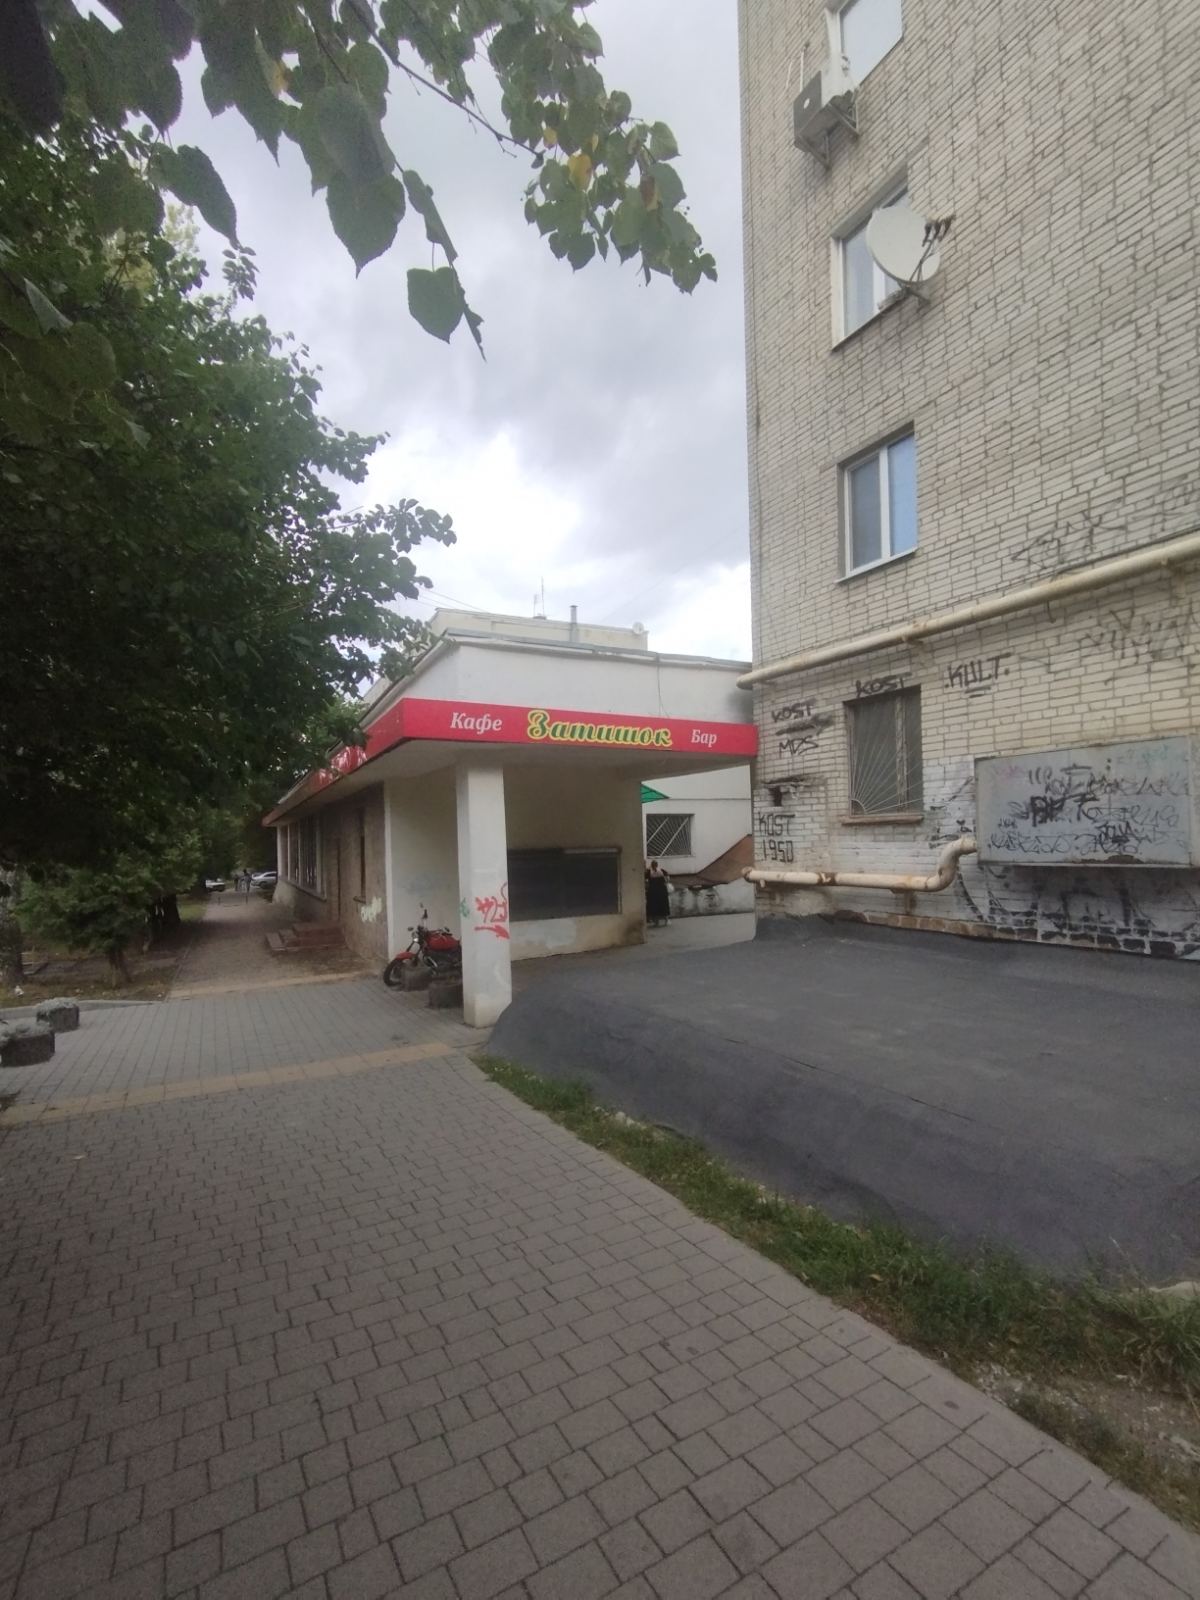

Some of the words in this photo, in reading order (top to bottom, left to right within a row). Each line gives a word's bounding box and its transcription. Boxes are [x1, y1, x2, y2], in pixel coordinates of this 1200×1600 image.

[450, 712, 502, 735] Кафе
[527, 709, 673, 747] Затишок
[691, 728, 718, 749] Бар
